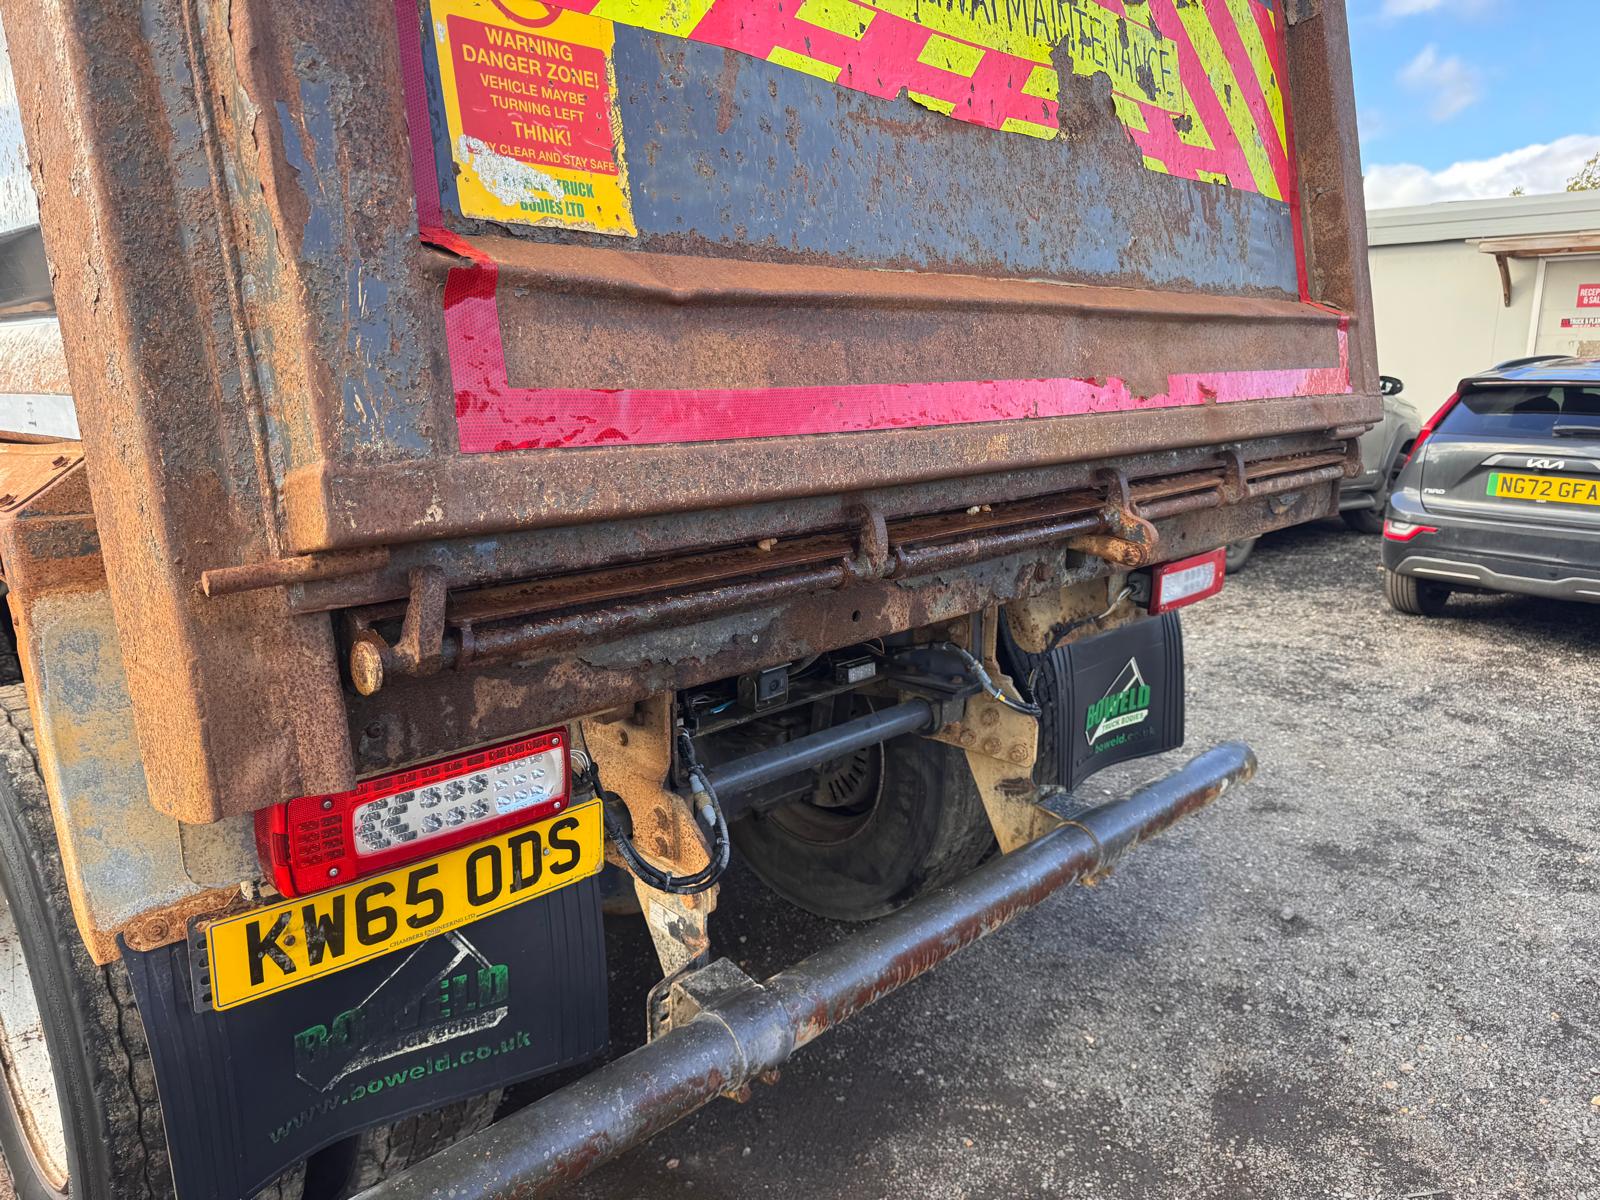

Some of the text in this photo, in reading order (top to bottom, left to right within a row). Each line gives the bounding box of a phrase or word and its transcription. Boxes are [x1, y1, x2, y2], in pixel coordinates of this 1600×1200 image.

[485, 27, 573, 62] WARNING
[462, 44, 599, 90] DANGER ZONE!
[480, 72, 587, 106] VEHICLE MAYBE
[490, 94, 584, 123] TURNING LEFT
[512, 121, 572, 147] THINK!
[500, 144, 537, 160] CLEAR
[539, 152, 561, 164] AND
[563, 155, 587, 167] STAY
[590, 159, 615, 172] SAFE
[565, 202, 585, 218] LTD
[1501, 476, 1598, 500] NG72 GFA
[1086, 685, 1151, 731] BOWELD
[246, 817, 581, 988] KW65 ODS
[390, 913, 476, 948] CHAMBERS ENGINEERING LTD
